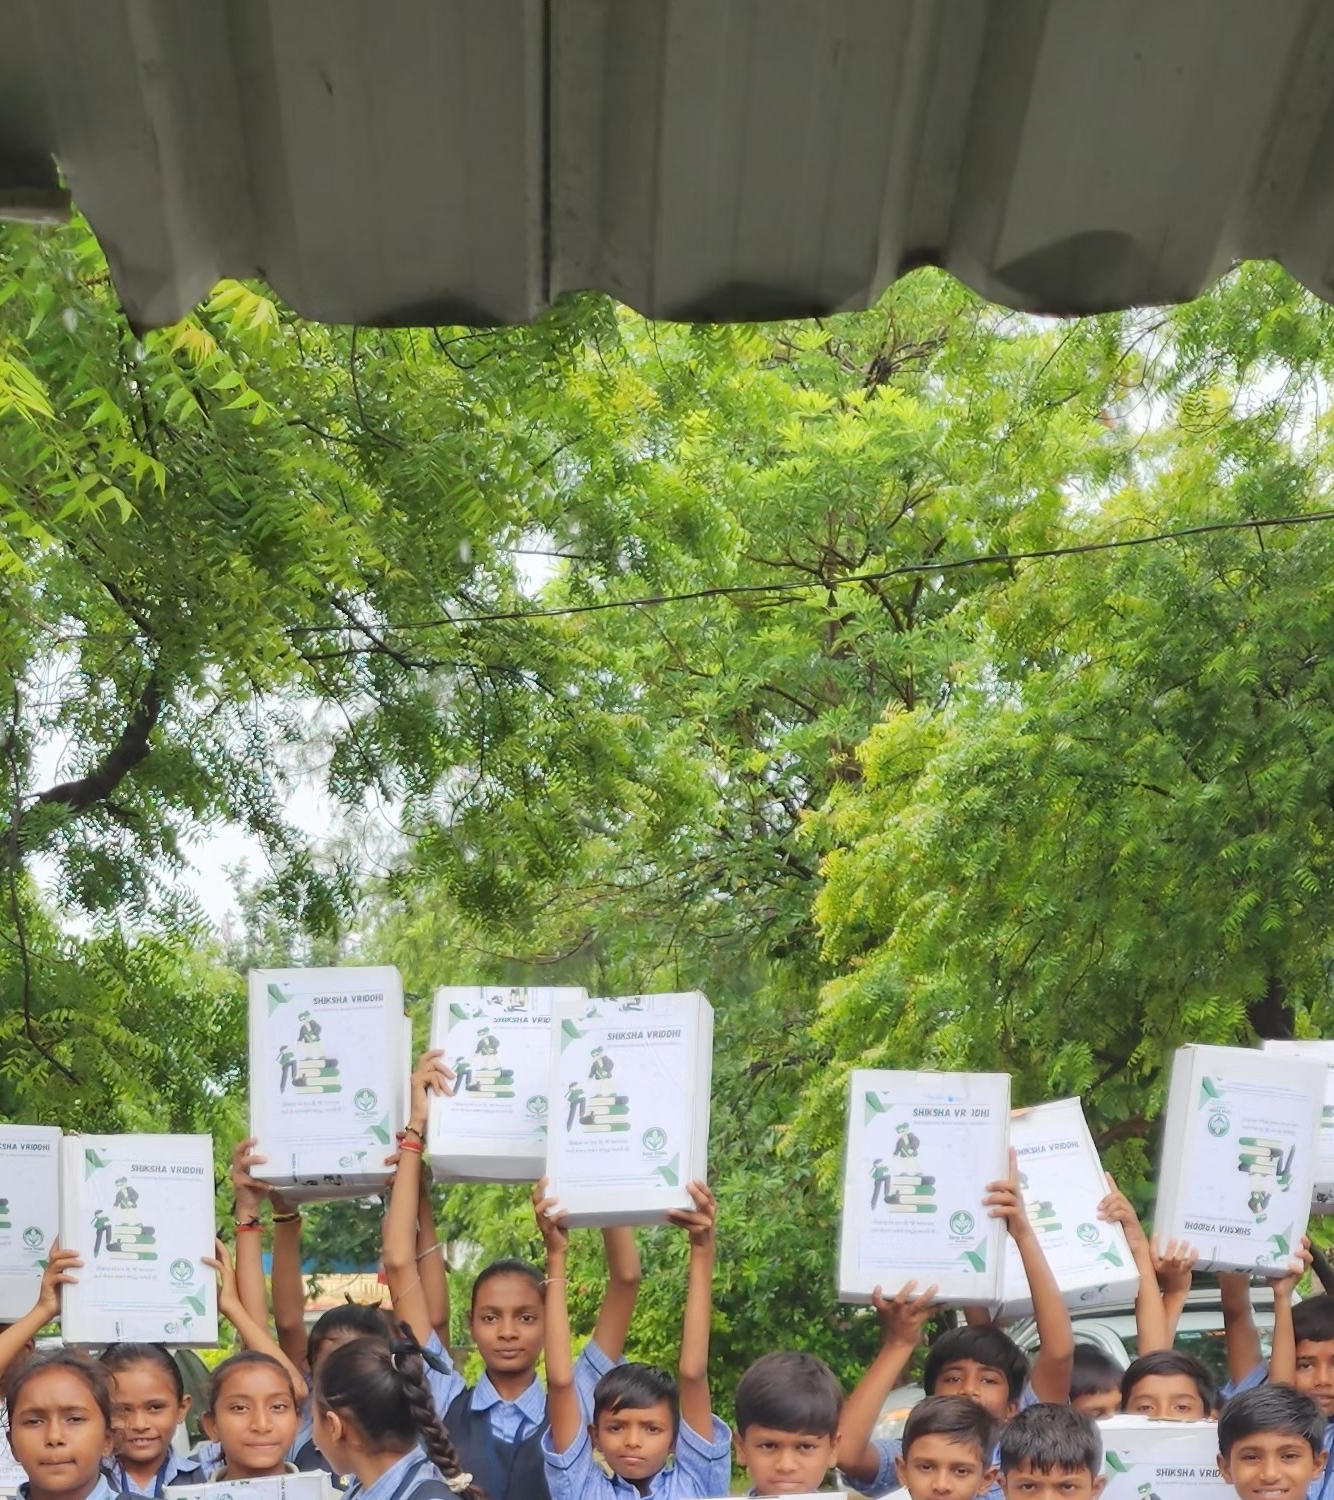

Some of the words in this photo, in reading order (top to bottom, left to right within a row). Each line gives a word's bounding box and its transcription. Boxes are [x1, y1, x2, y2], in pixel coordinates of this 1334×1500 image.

[313, 995, 348, 1005] SHIKSHA
[351, 994, 384, 1003] VRIDDHI
[607, 1032, 643, 1041] SHIKSHA
[647, 1030, 681, 1039] VRIDDHI
[913, 1108, 951, 1118] SHIKSHA
[20, 1143, 50, 1151] VRIDDHI
[1049, 1141, 1079, 1152] VRIDDHI
[131, 1164, 167, 1173] SHIKSHA
[171, 1166, 204, 1175] VRIDDHI
[1184, 1221, 1215, 1232] VRIDDHI
[1219, 1225, 1251, 1236] SHIKSHA
[1155, 1468, 1195, 1477] SHIKSHA
